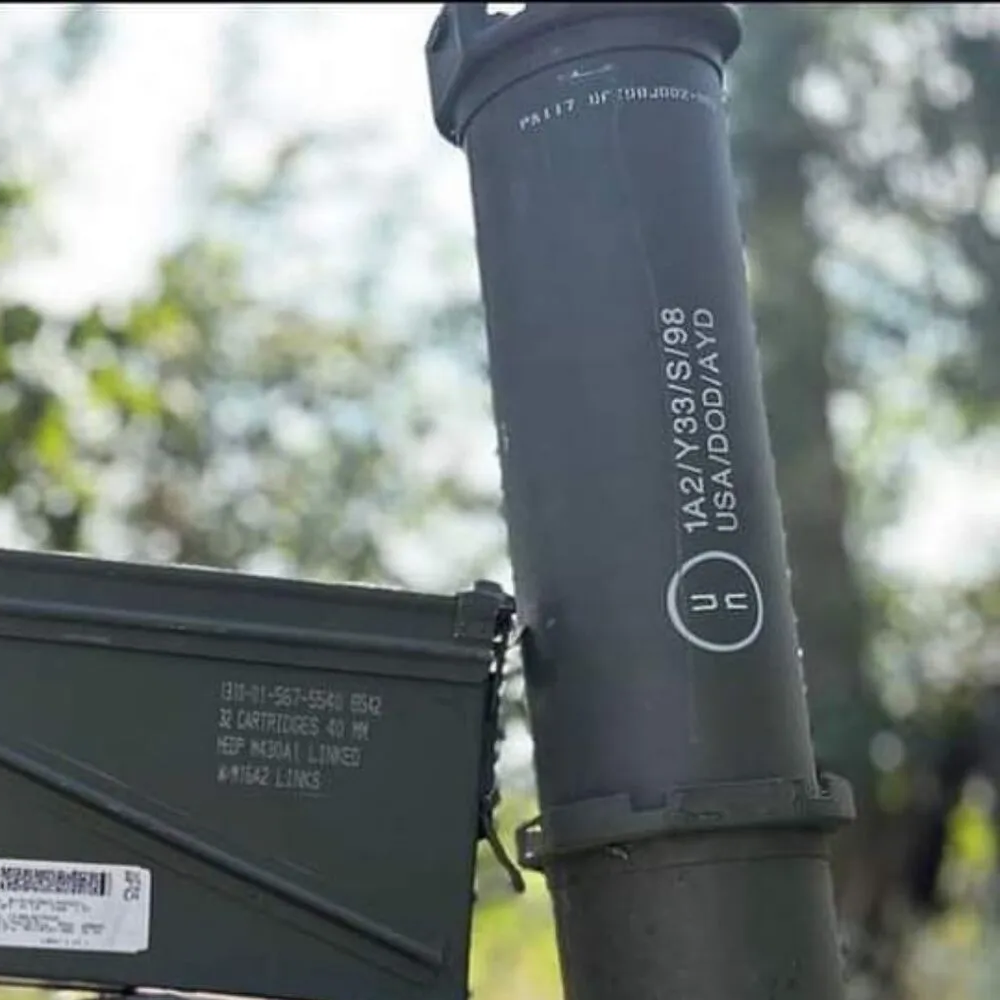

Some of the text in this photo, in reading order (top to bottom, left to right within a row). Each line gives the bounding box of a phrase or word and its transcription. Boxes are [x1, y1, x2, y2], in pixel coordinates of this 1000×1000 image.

[661, 307, 709, 533] 1A2/Y33/S/98
[693, 308, 739, 532] USA/DOD/AYD
[237, 709, 320, 735] CARTRIDGES
[326, 717, 344, 738] 40
[275, 768, 321, 790] LINKS
